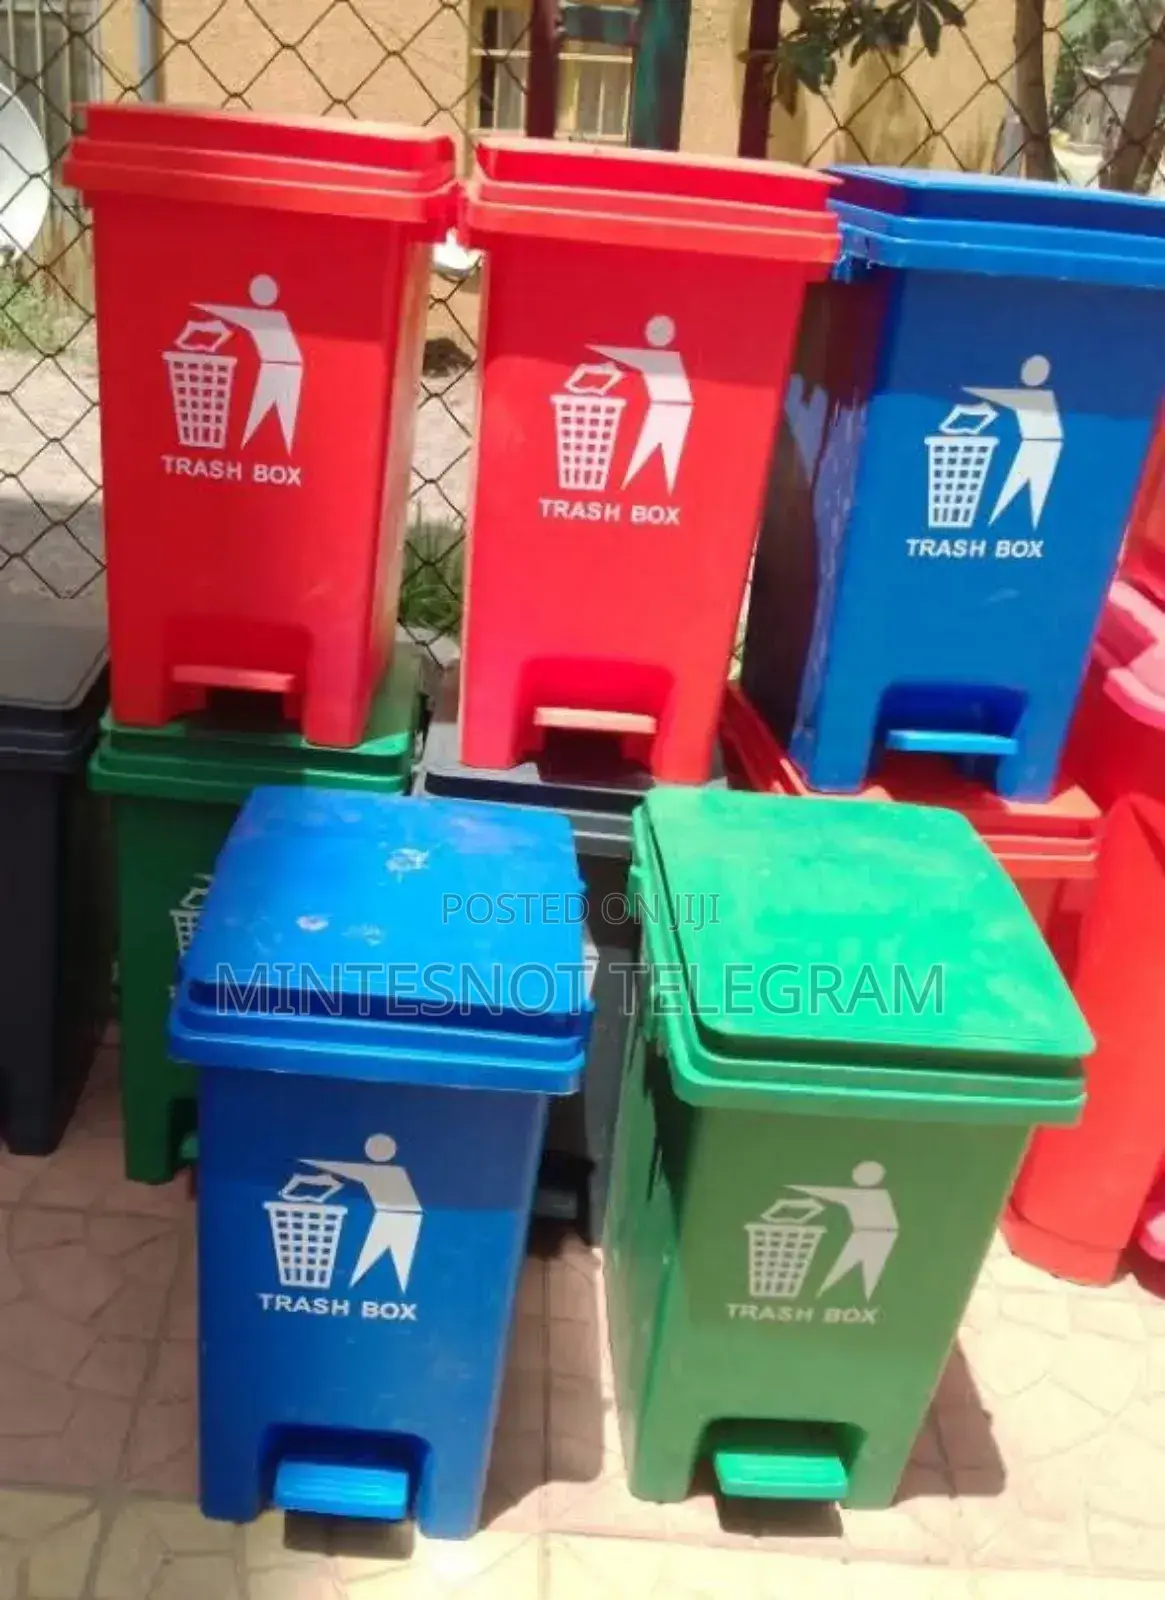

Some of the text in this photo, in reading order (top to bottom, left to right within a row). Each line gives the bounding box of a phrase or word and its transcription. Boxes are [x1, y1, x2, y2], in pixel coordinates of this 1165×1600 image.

[161, 455, 302, 487] TRASH BOX
[539, 498, 681, 526] TRASH BOX
[906, 538, 1044, 561] TRASH BOX
[258, 1292, 418, 1322] TRASH BOX
[727, 1302, 878, 1325] TRASH BOX
